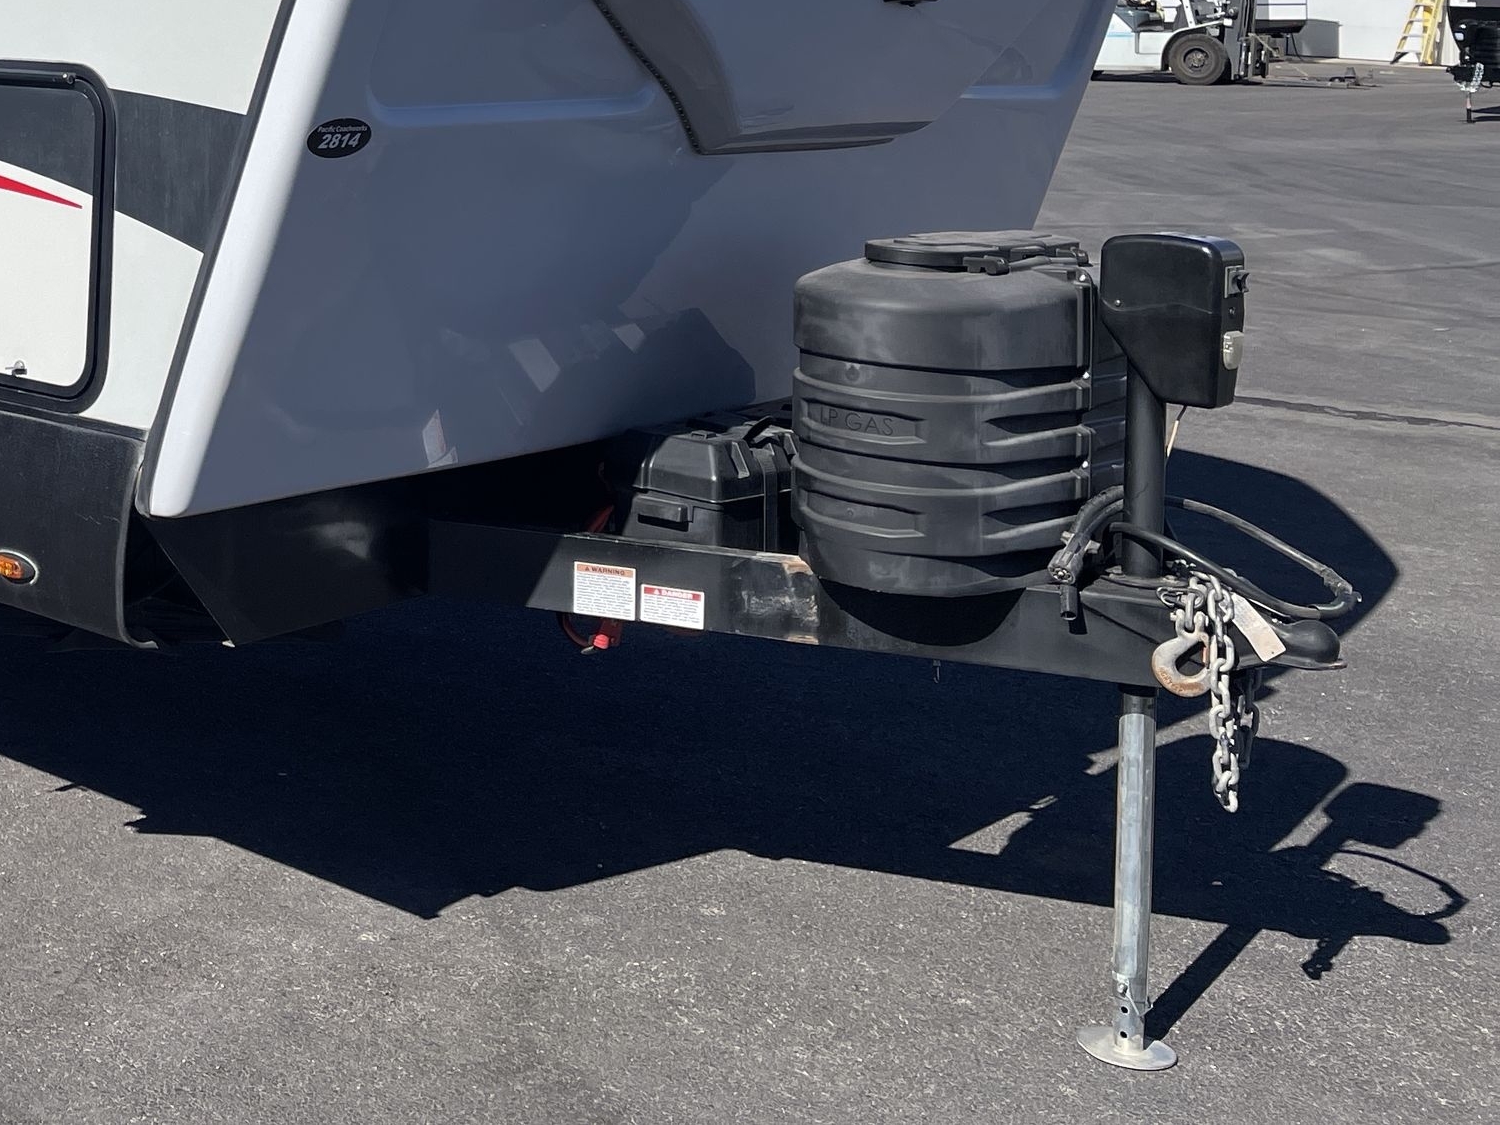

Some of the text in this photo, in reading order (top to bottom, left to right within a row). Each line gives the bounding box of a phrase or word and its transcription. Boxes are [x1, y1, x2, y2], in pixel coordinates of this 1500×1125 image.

[317, 133, 362, 149] 2814
[820, 406, 894, 436] LP GAS
[591, 565, 625, 576] WARNING
[661, 589, 694, 600] DANGER
